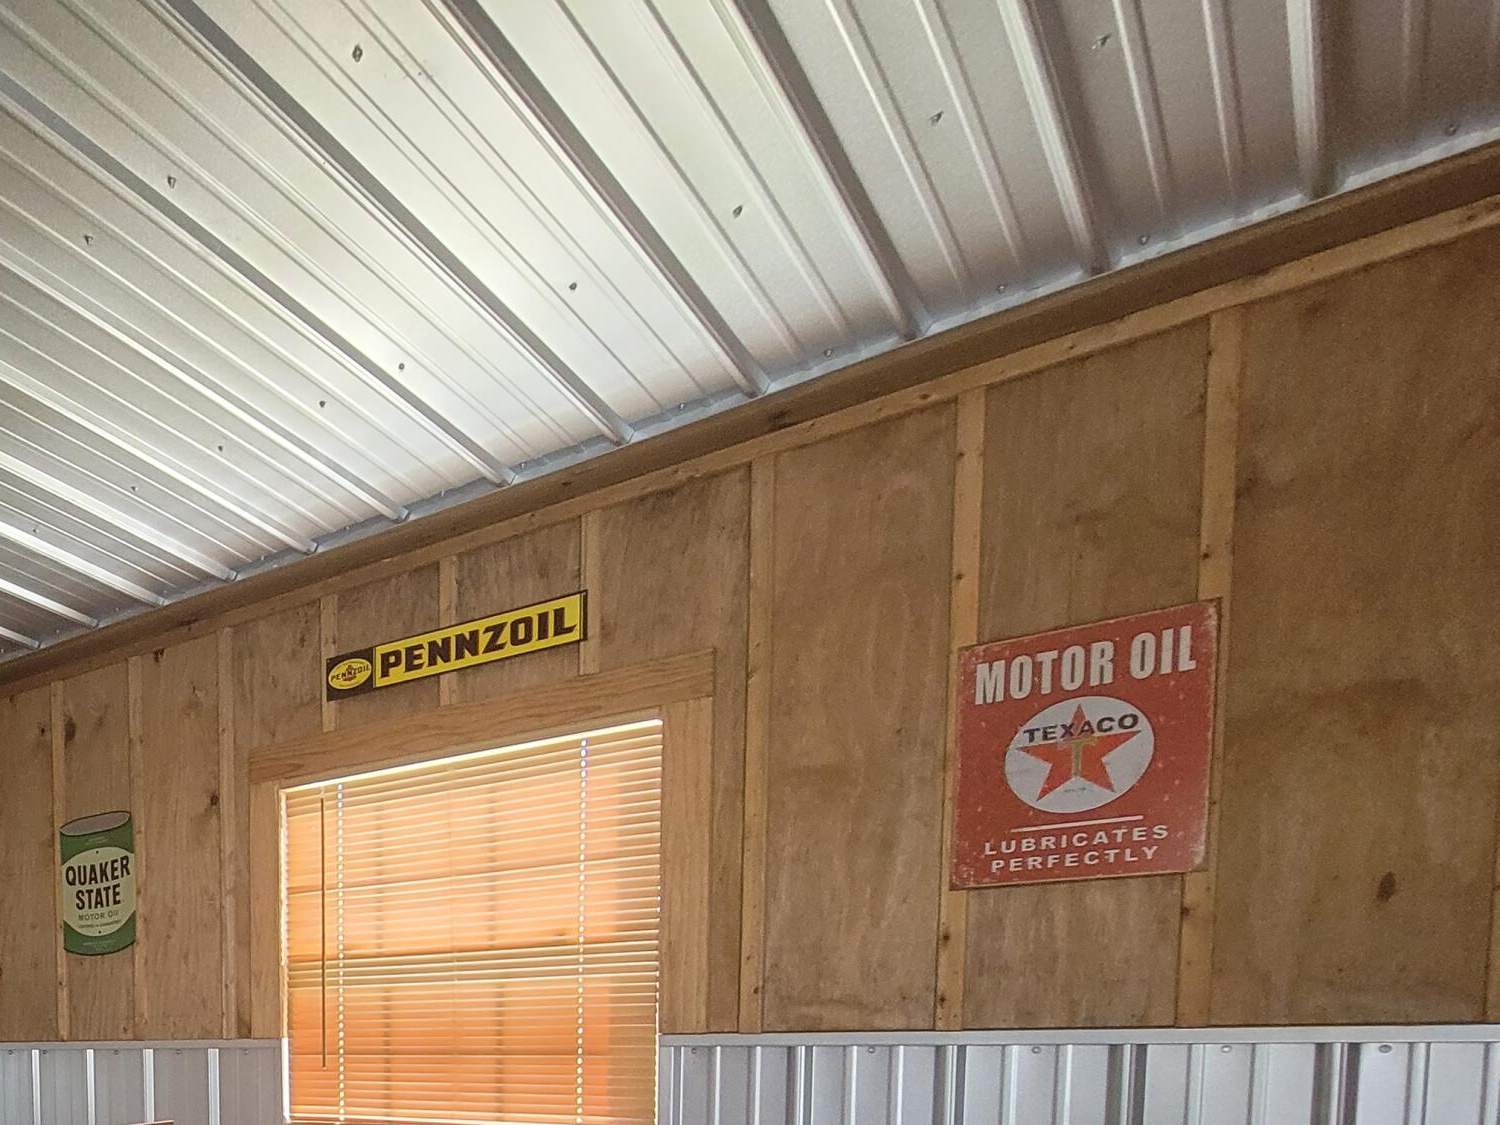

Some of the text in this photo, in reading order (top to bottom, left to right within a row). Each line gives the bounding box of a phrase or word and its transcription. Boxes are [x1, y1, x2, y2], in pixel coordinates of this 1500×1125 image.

[380, 607, 577, 678] PENNZOIL
[974, 625, 1197, 705] MOTOR OIL
[1023, 713, 1140, 744] TEXACO
[984, 824, 1169, 856] LUBRICATES
[65, 855, 131, 887] QUAKER
[990, 846, 1159, 873] PERFECTLY
[75, 883, 121, 911] STATE
